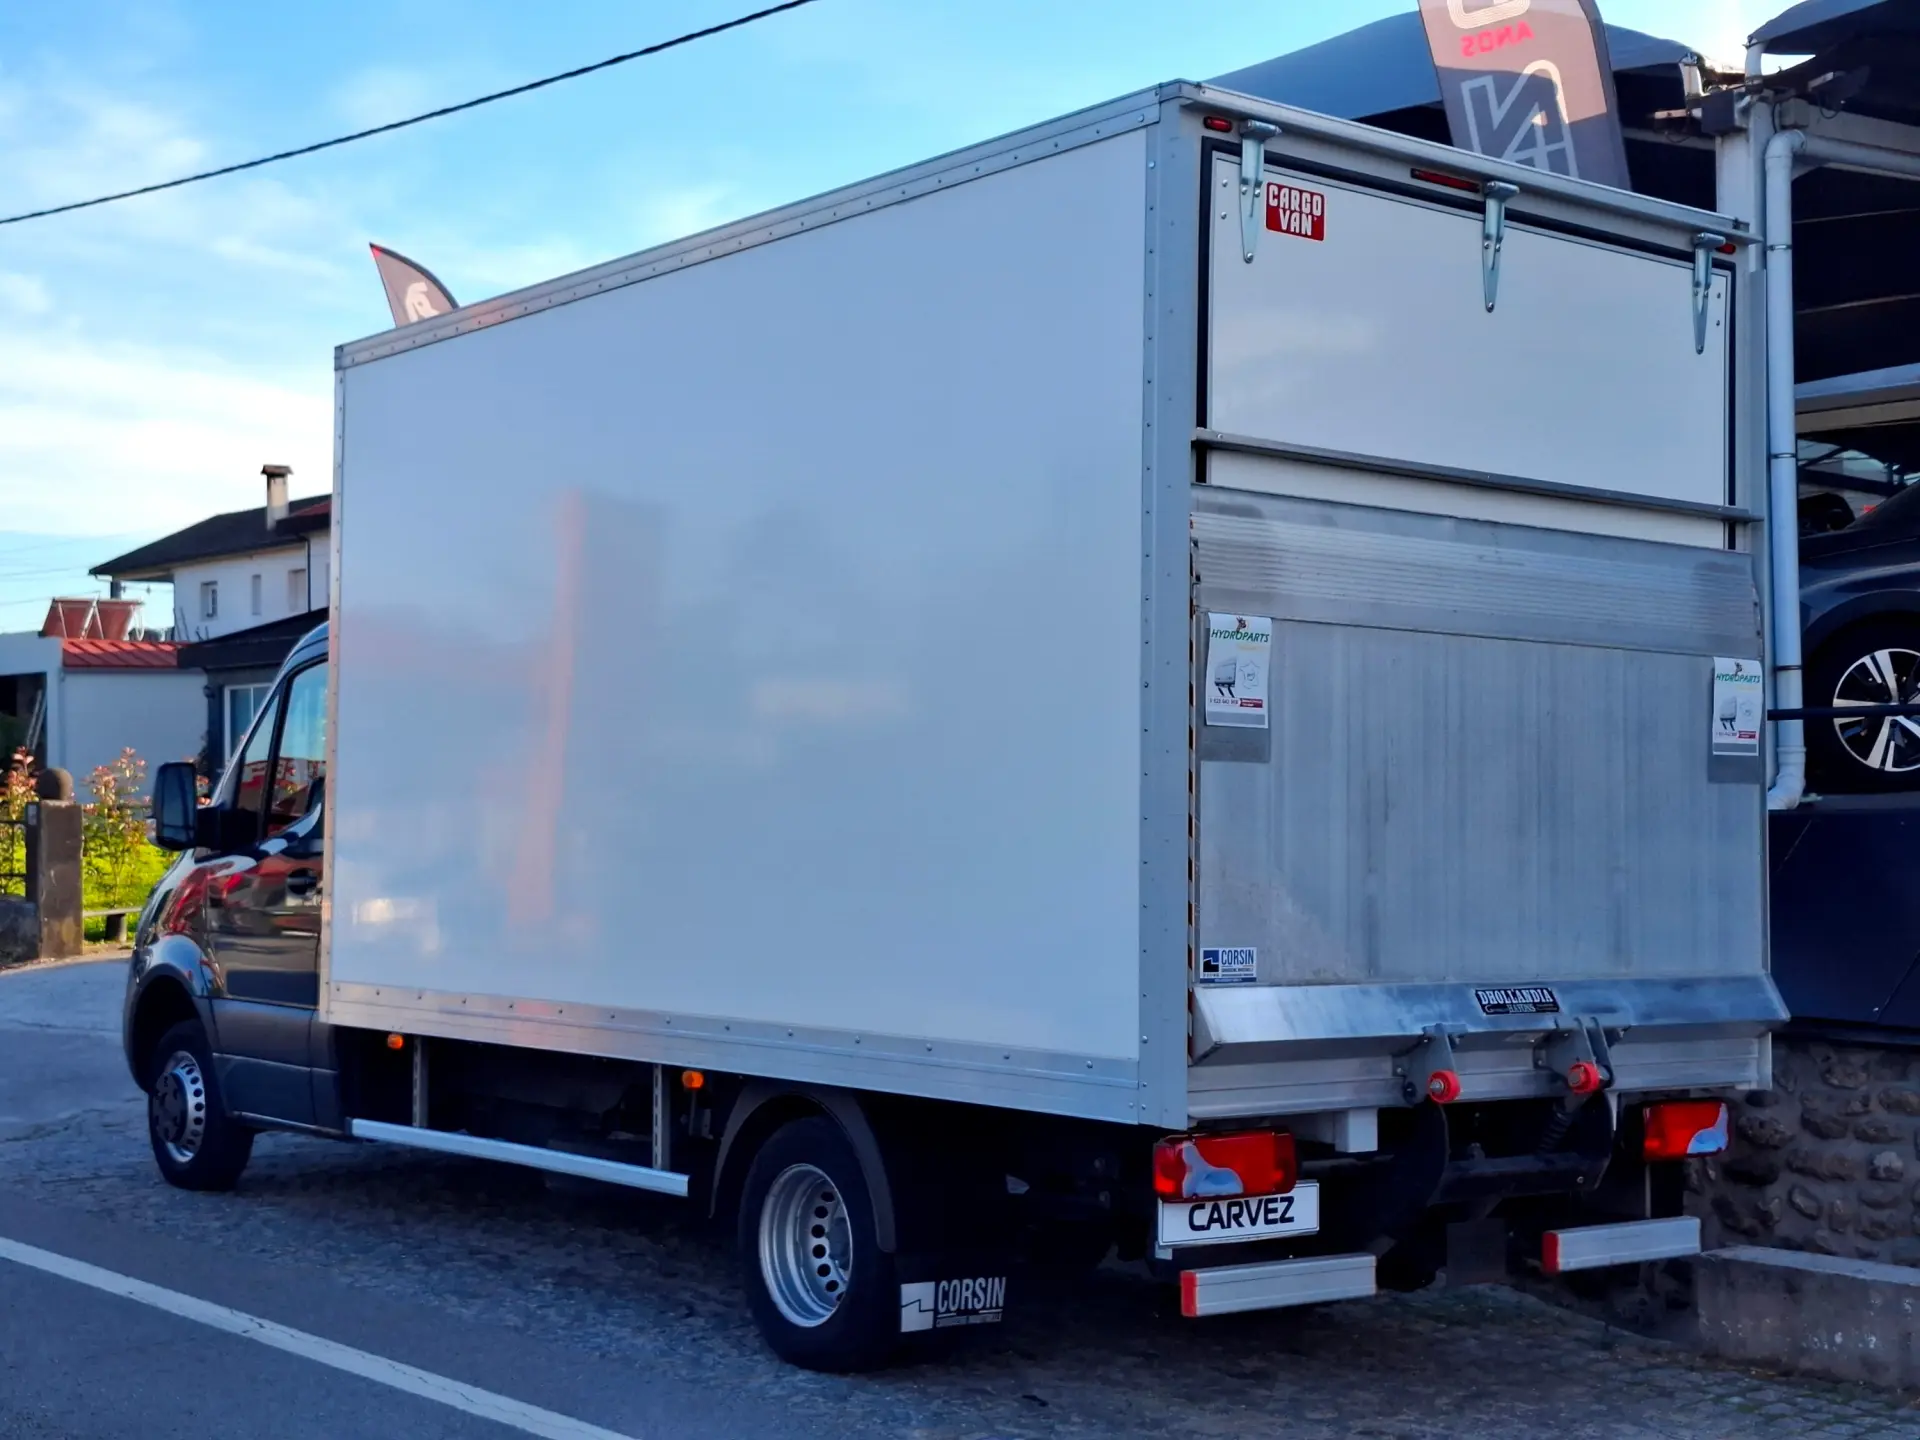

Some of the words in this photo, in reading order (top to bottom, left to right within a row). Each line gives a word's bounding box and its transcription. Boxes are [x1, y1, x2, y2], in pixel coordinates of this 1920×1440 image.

[1269, 184, 1322, 217] CARGO
[1279, 208, 1312, 236] VAN
[1211, 628, 1270, 643] HYDROPARTS
[1715, 672, 1761, 684] HYDROPARTS
[1221, 949, 1254, 965] CORSIN
[1477, 988, 1554, 1005] DHOLLANDIA
[1188, 1195, 1295, 1232] CARVEZ
[937, 1277, 1007, 1313] CORSIN
